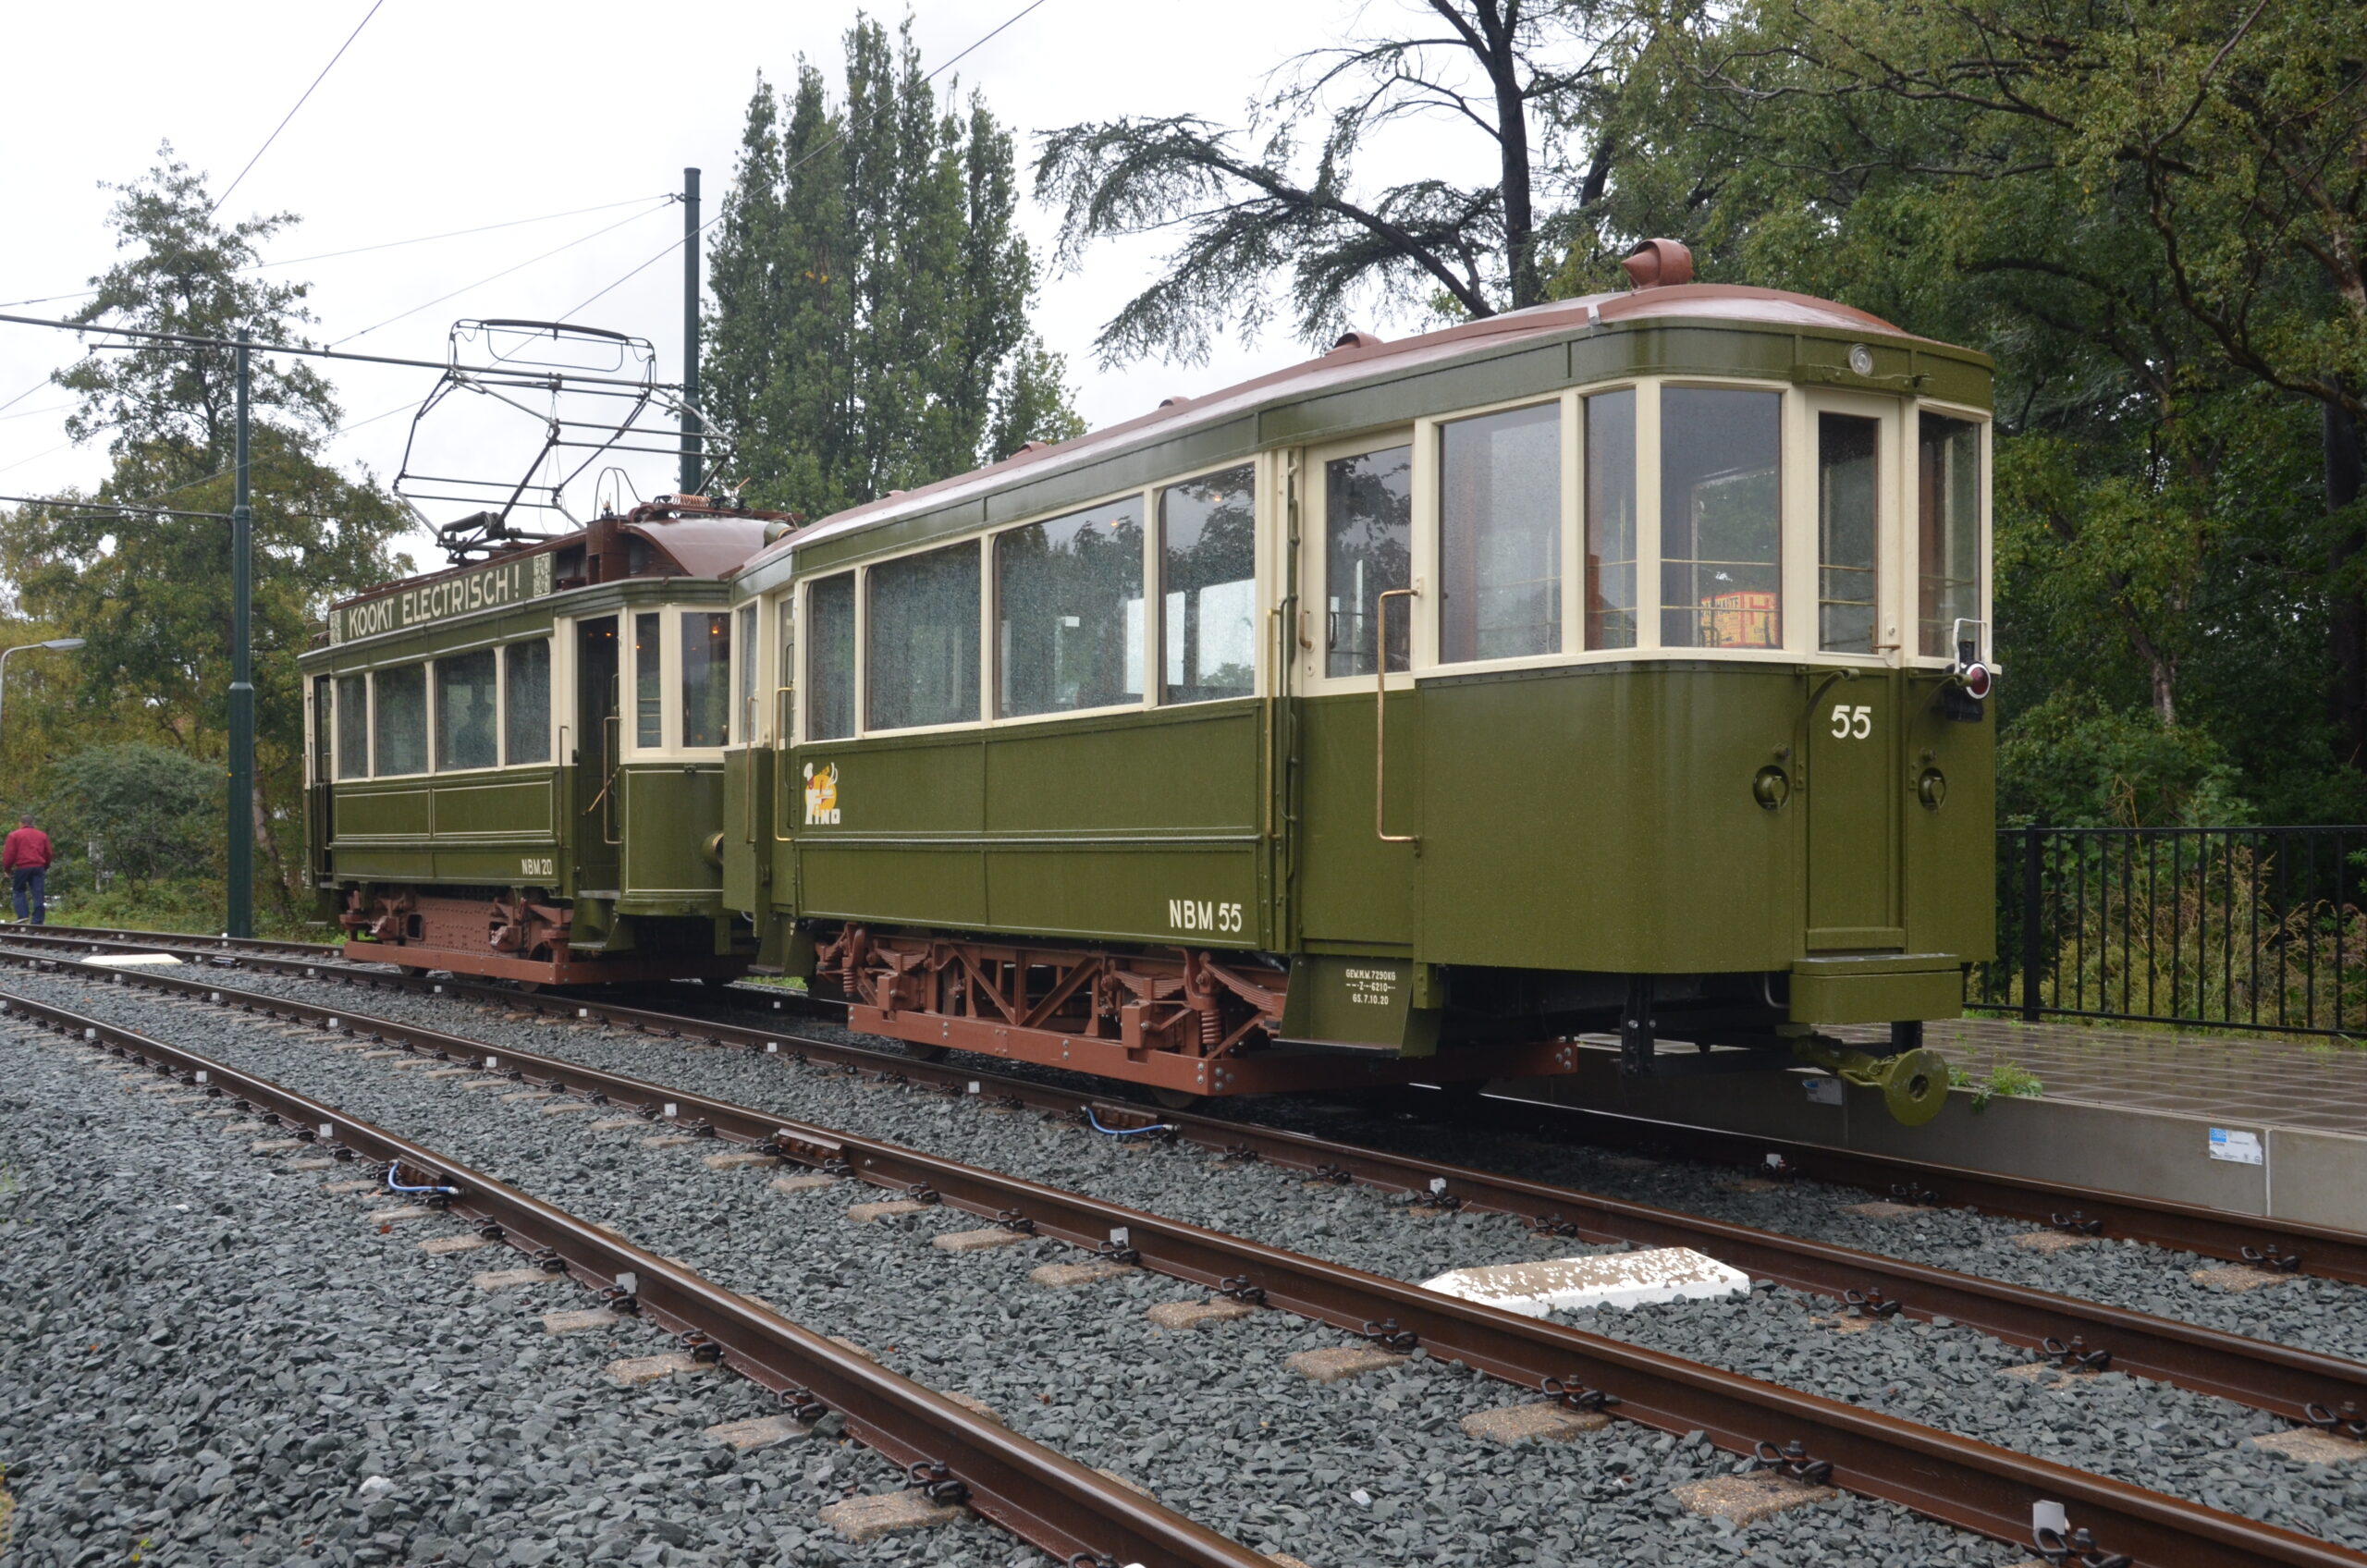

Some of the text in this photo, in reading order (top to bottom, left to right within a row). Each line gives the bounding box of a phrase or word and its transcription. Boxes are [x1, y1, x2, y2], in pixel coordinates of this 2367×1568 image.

[349, 596, 394, 639] KOOKT
[1831, 704, 1871, 740] 55
[521, 858, 553, 876] NBM 20
[1169, 899, 1242, 933] NBM 55
